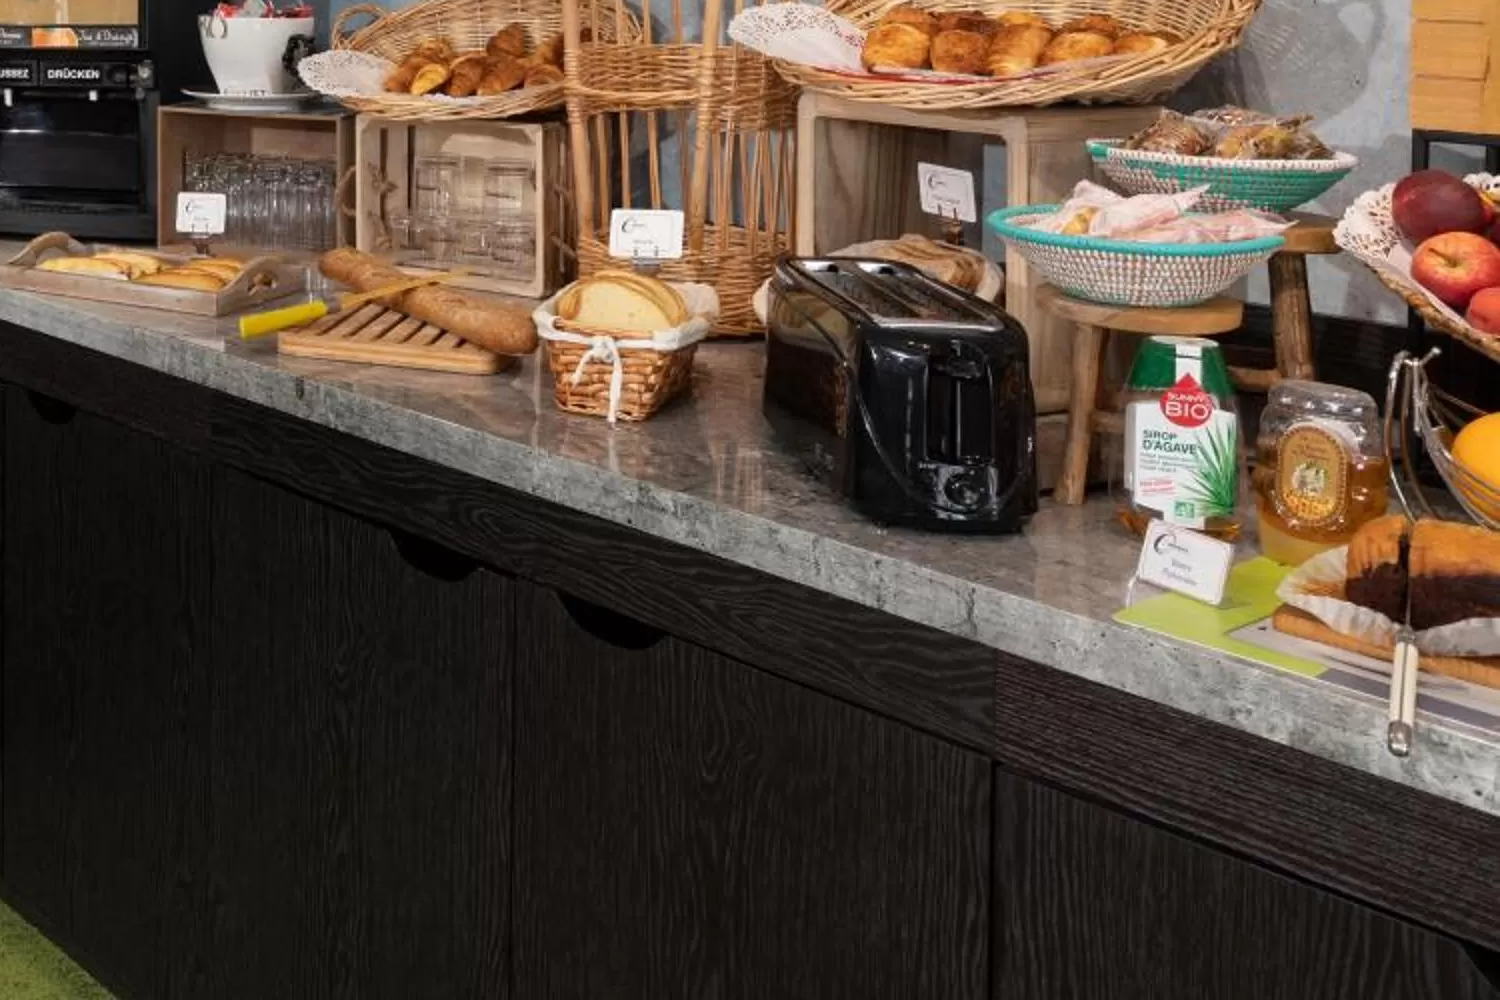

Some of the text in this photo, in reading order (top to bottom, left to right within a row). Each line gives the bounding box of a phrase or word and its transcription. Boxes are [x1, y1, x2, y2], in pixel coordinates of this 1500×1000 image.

[47, 67, 101, 80] DRÜCKEN
[1165, 401, 1209, 420] BIO
[1143, 429, 1178, 441] SIROP
[1143, 440, 1197, 455] D'AGAVE
